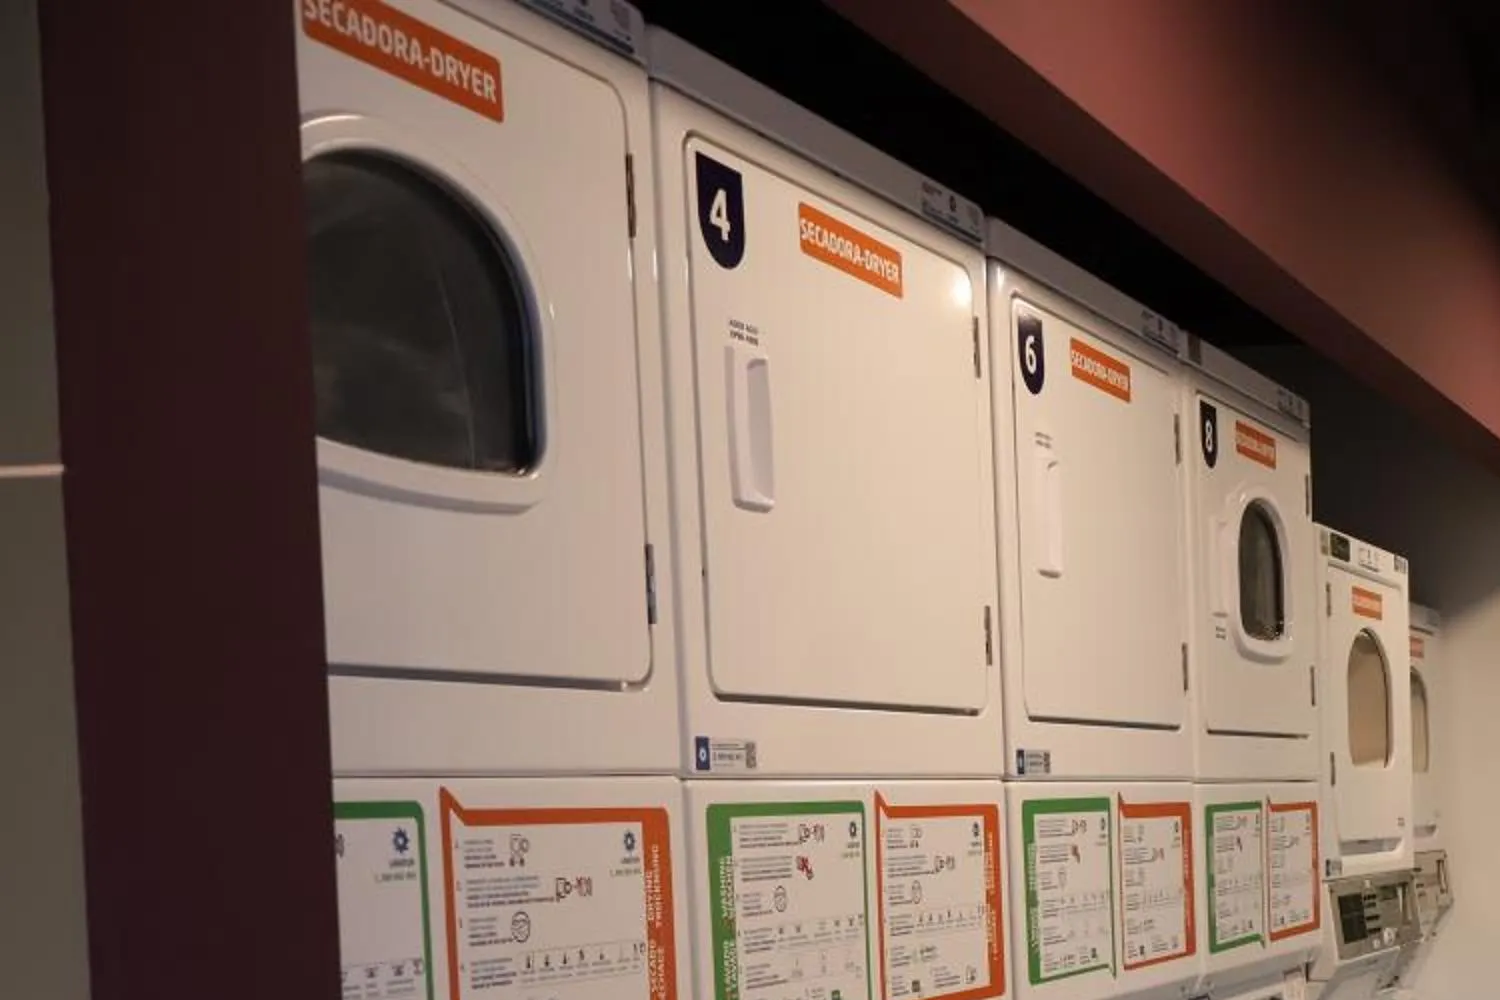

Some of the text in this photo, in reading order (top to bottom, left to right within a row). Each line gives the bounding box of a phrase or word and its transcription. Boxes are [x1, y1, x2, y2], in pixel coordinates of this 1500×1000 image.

[303, 0, 497, 103] SECADORA-DRYER
[709, 188, 731, 241] 4
[799, 218, 900, 284] SECADORA-DRYER
[1025, 335, 1037, 375] 6
[1204, 419, 1214, 453] 8
